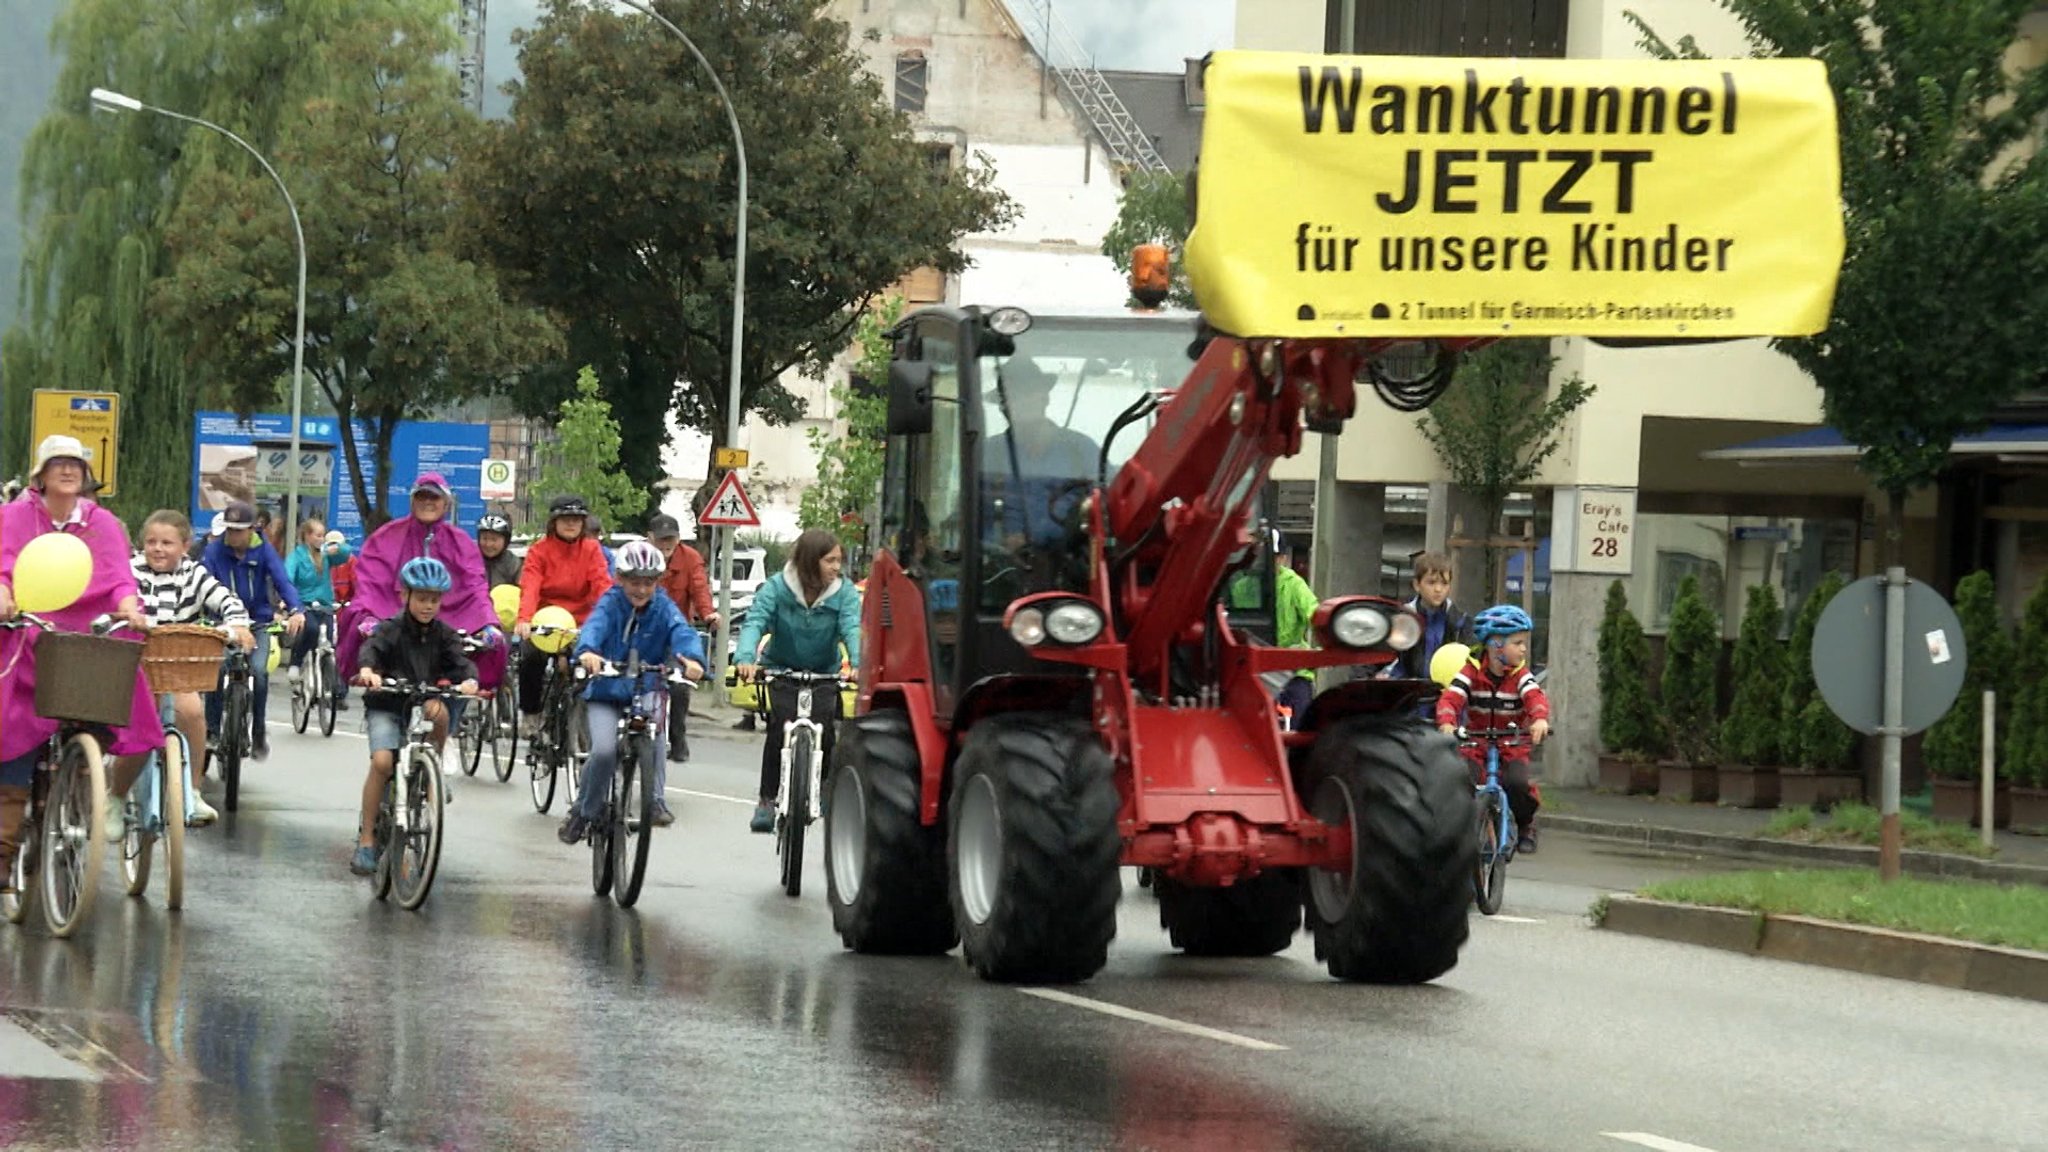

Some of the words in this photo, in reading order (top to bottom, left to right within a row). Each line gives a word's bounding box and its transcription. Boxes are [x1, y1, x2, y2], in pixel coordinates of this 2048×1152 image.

[1299, 66, 1738, 134] Wanktunnel
[1375, 150, 1653, 214] JETZT
[1296, 223, 1360, 272] für
[1380, 235, 1549, 272] unsere
[1571, 223, 1734, 272] Kinder
[1400, 302, 1410, 320] 2
[1417, 302, 1474, 320] Tunnel
[1480, 302, 1505, 320] für
[1510, 302, 1735, 320] Garmisch-Partenkirchen
[493, 467, 504, 478] H
[1582, 503, 1622, 518] Eray's
[1591, 537, 1618, 557] 28
